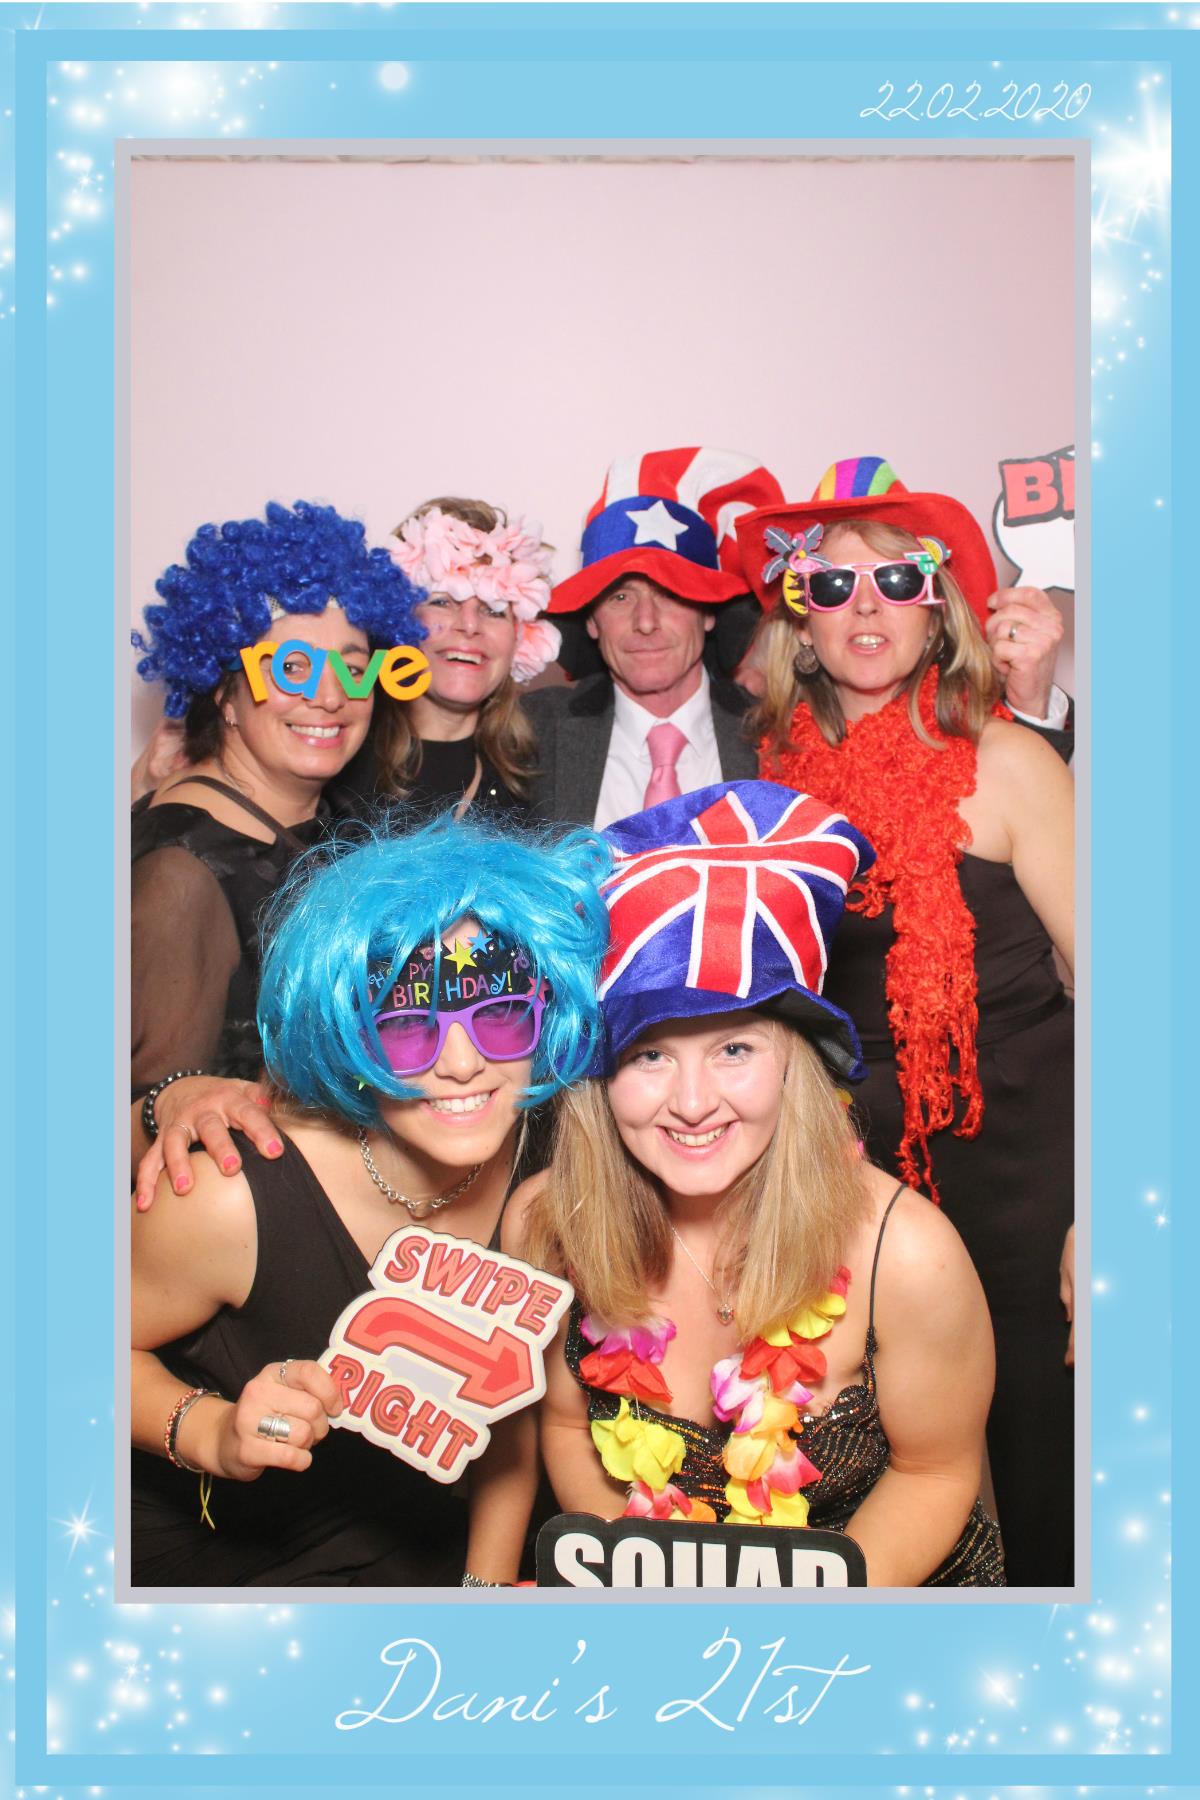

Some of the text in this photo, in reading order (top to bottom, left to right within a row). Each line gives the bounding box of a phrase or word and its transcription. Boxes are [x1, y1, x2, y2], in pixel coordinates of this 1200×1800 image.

[1003, 458, 1075, 519] B
[239, 639, 433, 703] rave
[368, 962, 434, 989] HPY
[392, 970, 513, 1008] BIRHDAY!
[384, 1235, 562, 1335] SWIPE
[328, 1354, 478, 1471] RIGHT
